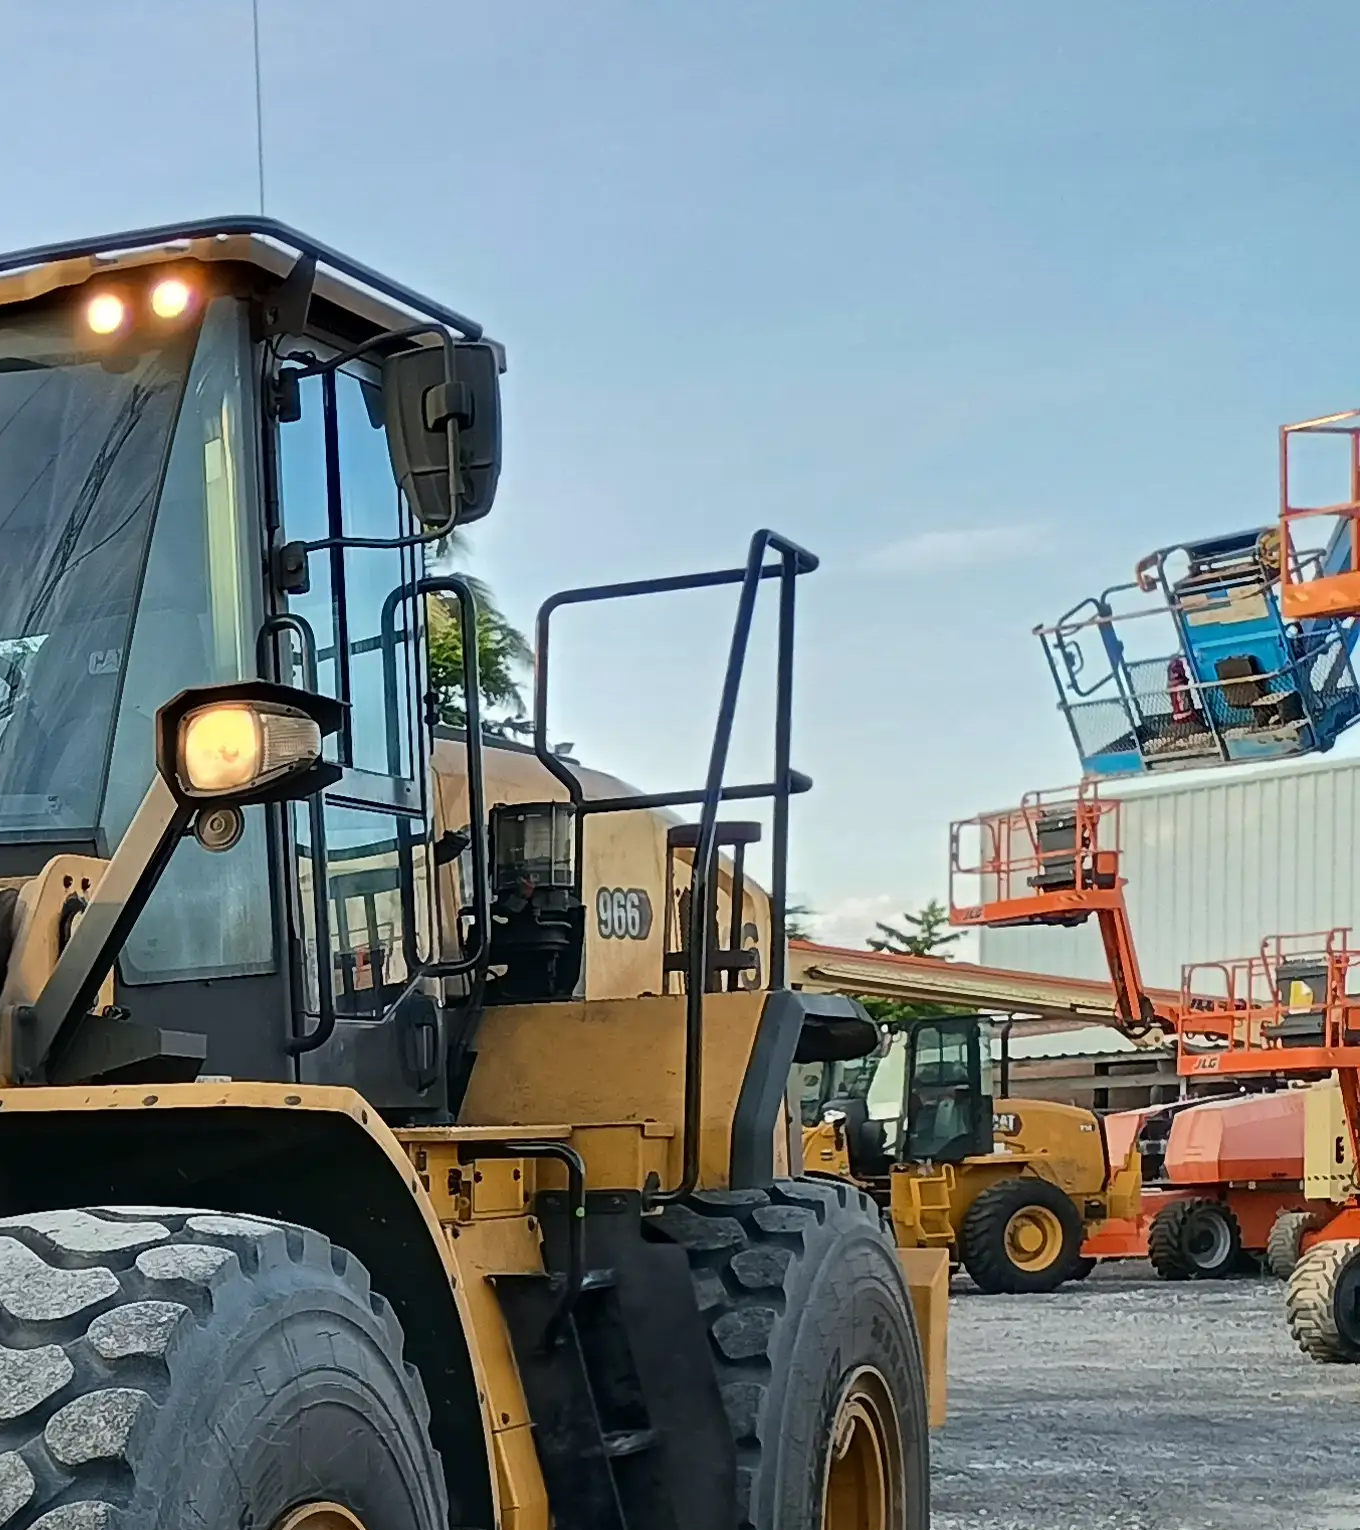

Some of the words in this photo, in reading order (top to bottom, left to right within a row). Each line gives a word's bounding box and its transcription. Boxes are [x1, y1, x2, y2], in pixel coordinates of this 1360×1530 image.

[598, 890, 640, 937] 966
[1194, 1056, 1217, 1070] JLG
[993, 1114, 1015, 1132] CAT
